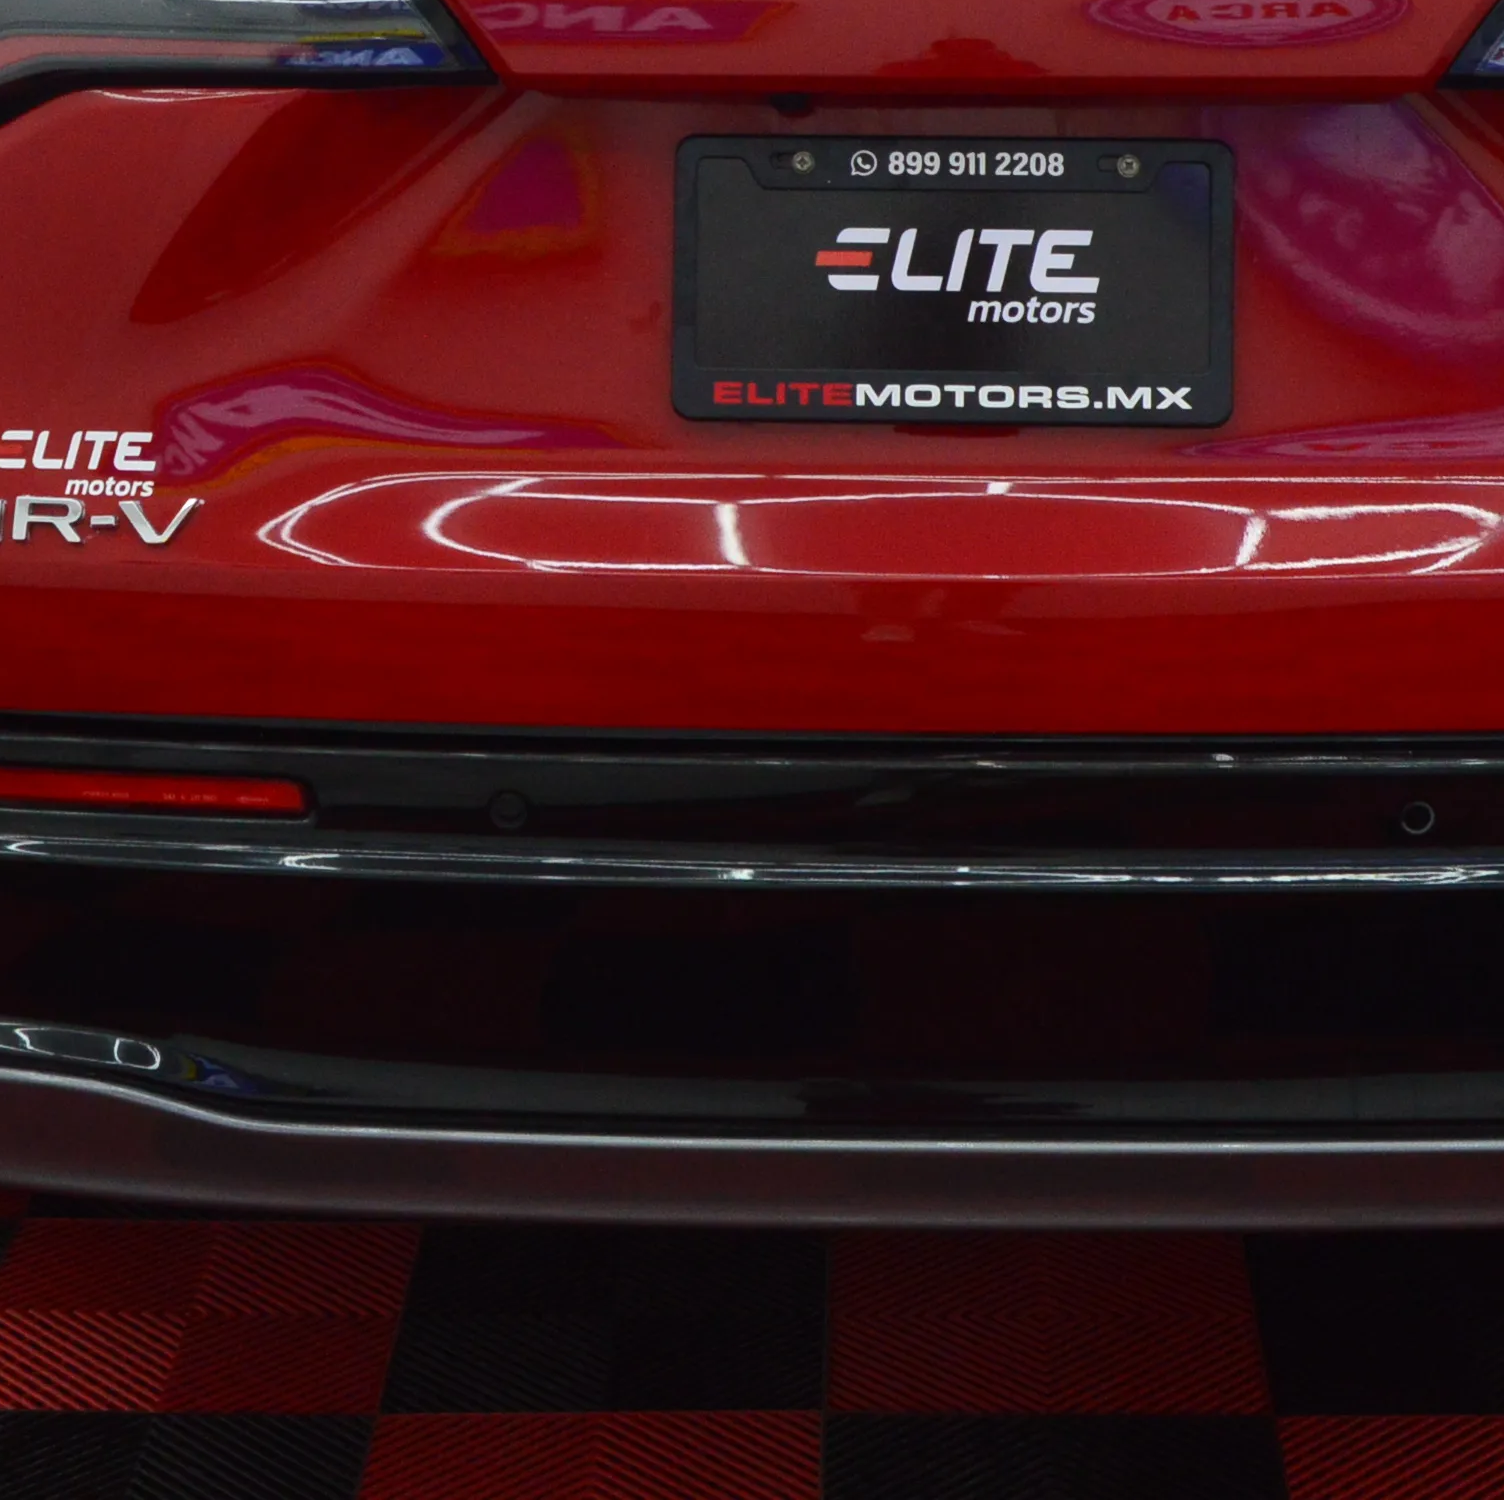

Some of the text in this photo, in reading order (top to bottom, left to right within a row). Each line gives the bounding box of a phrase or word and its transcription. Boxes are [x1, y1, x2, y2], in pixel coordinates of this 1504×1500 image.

[888, 151, 1065, 178] 899 911 2208
[815, 227, 1100, 294] ELITE
[968, 297, 1097, 324] motors
[713, 382, 1193, 411] ELITEMOTORS.MX
[65, 476, 155, 498] motors
